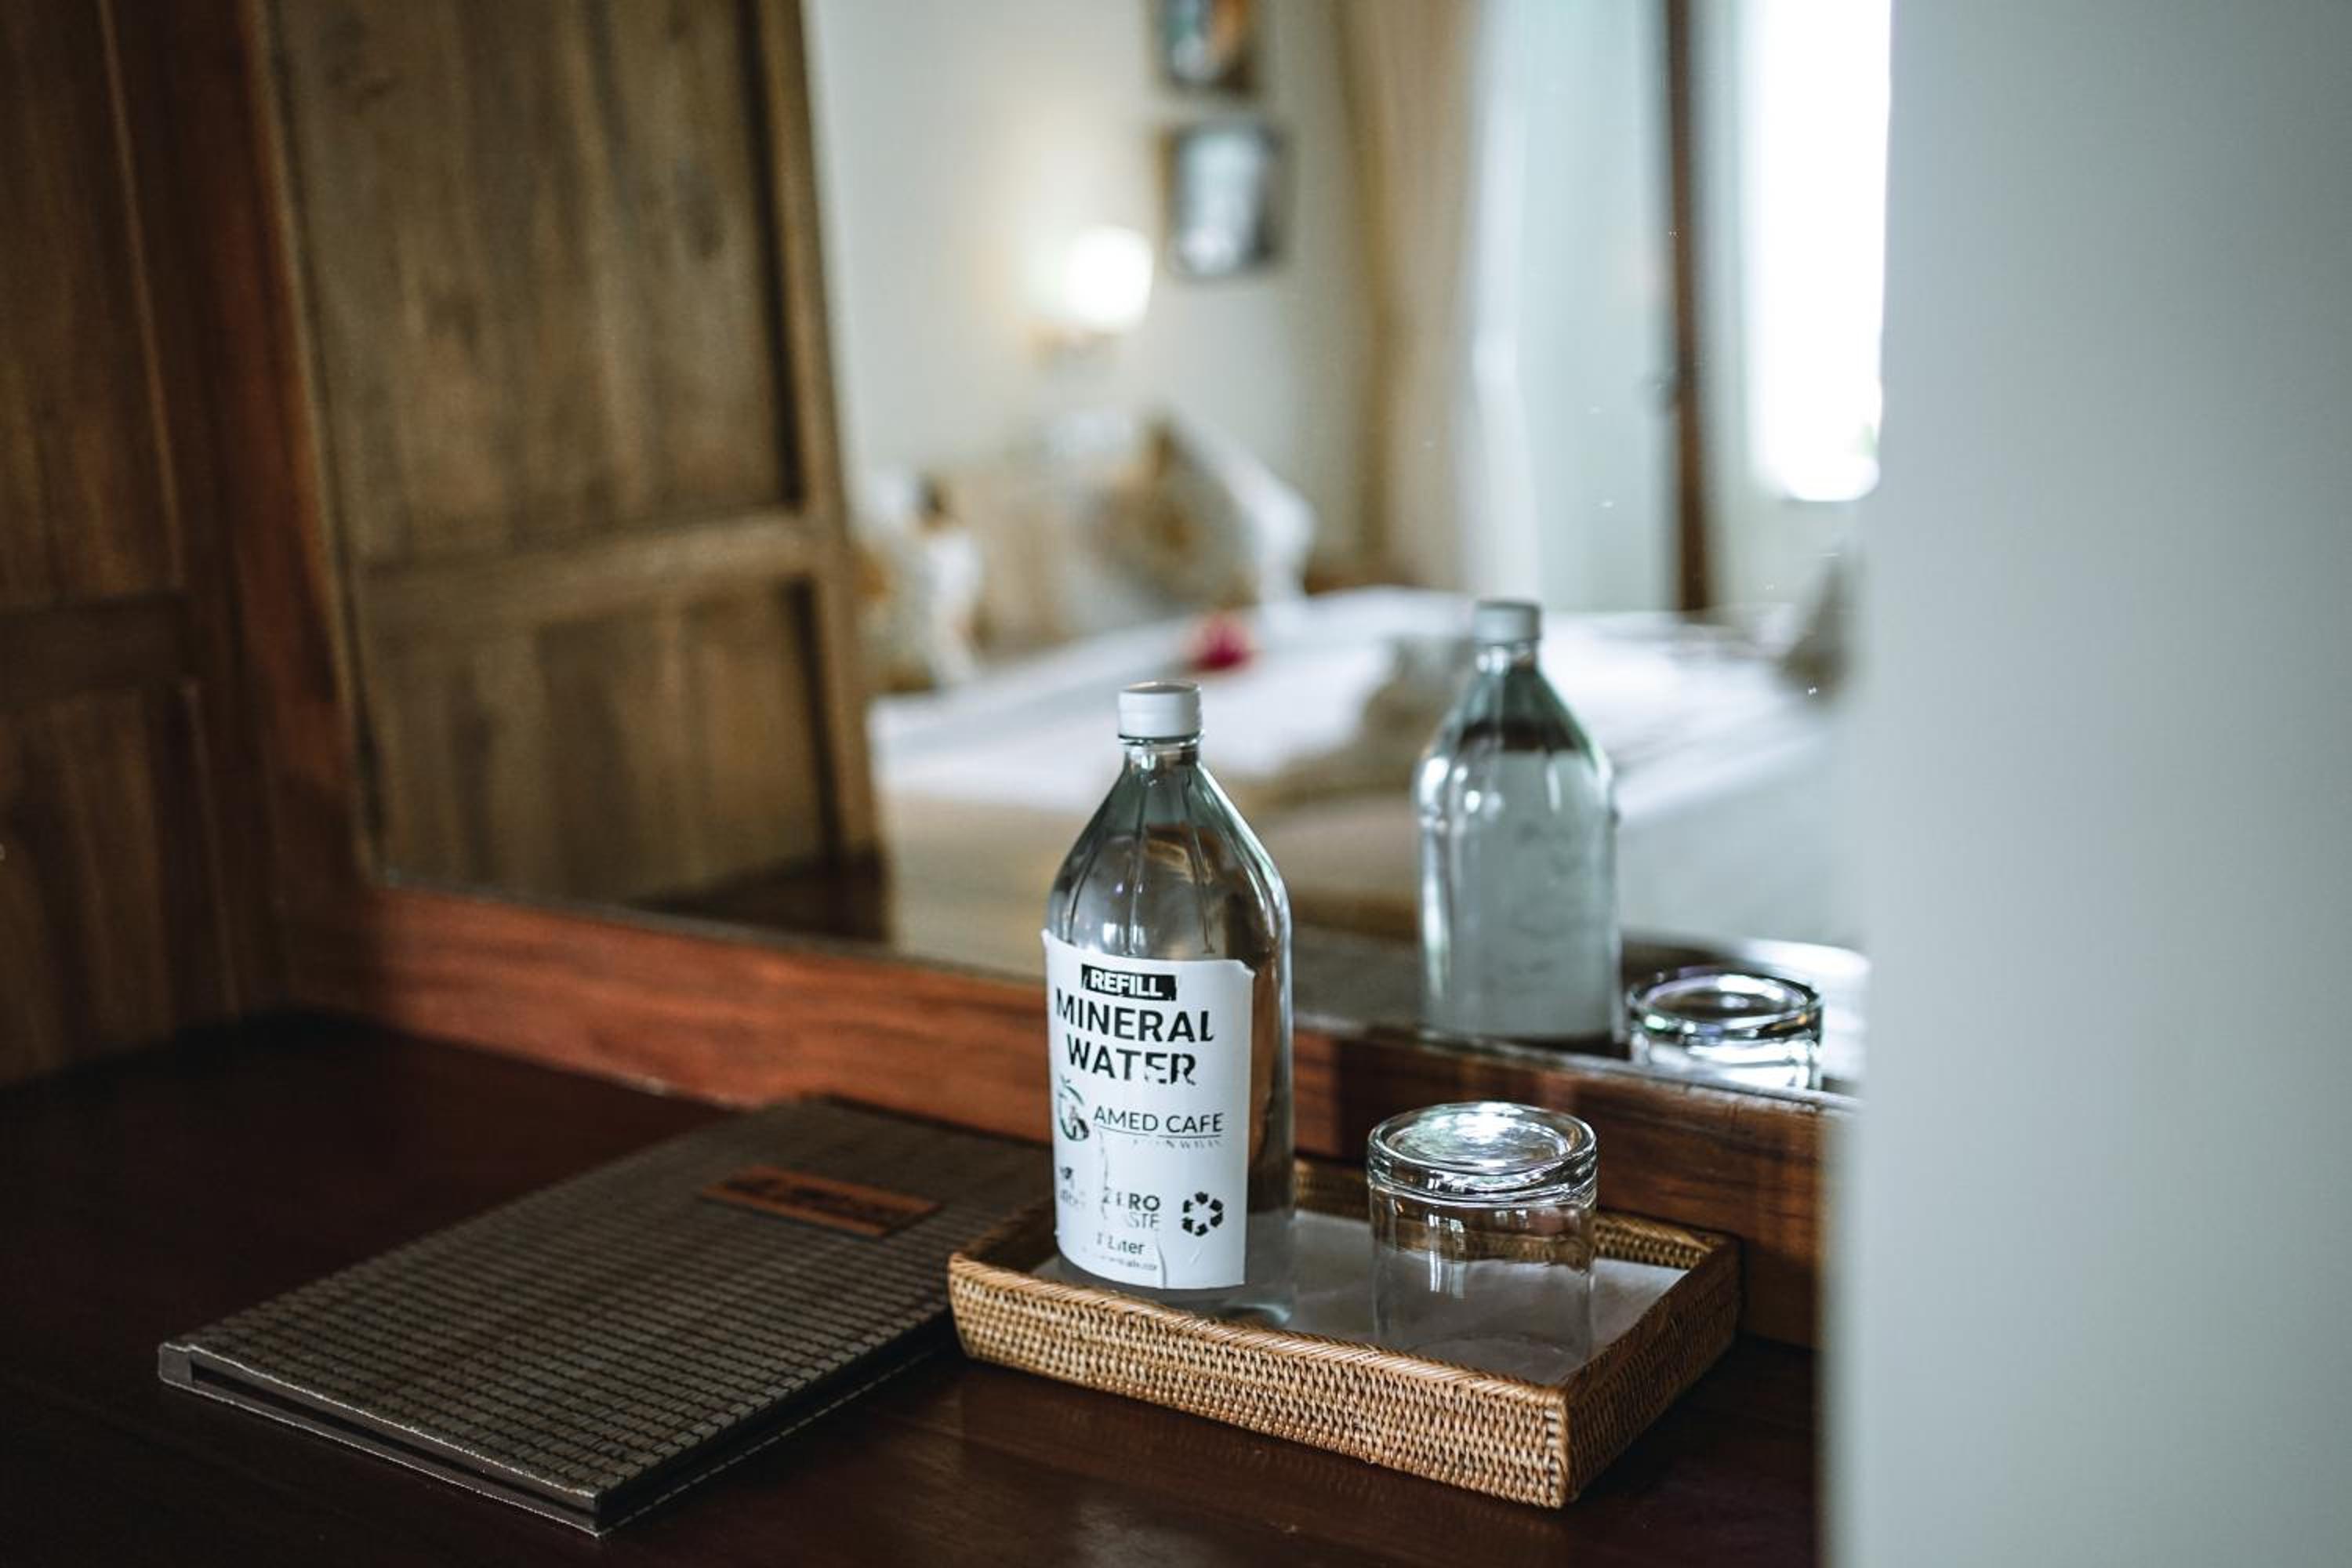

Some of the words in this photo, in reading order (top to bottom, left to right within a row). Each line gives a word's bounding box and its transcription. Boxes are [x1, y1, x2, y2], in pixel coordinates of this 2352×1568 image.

[1090, 968, 1163, 997] REFILL
[1055, 987, 1214, 1043] MINERAL
[1066, 1033, 1197, 1086] WATER
[1093, 1105, 1159, 1132] AMED
[1165, 1112, 1225, 1134] CAFE
